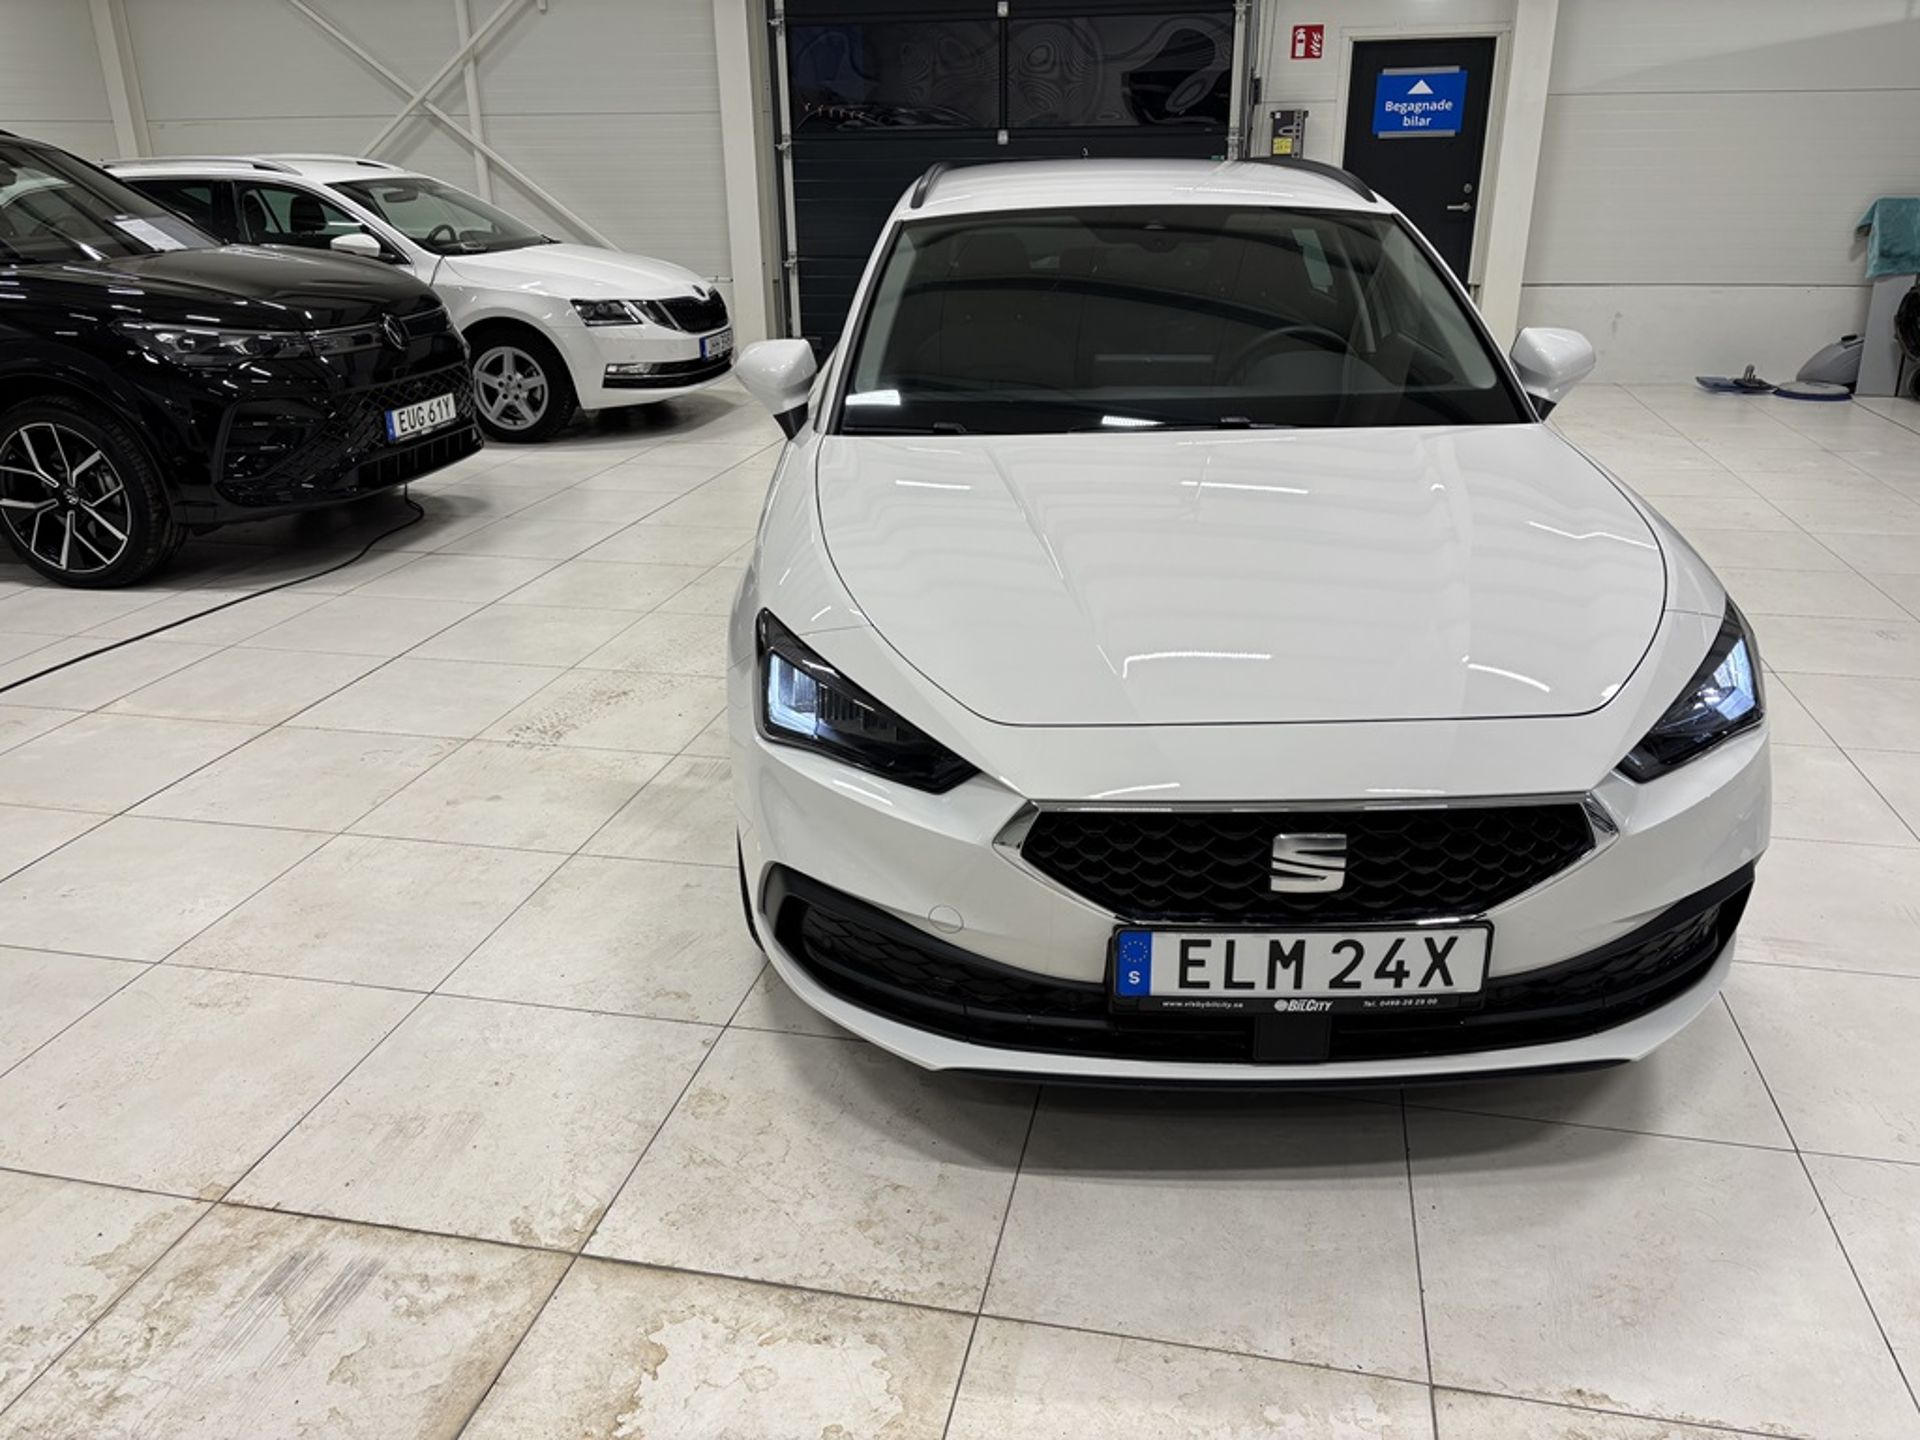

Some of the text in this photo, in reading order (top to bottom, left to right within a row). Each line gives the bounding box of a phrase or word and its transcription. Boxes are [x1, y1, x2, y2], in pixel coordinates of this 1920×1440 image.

[1385, 99, 1453, 114] Begagnade
[1403, 115, 1431, 127] bilar
[398, 396, 451, 433] EUG 61Y
[1178, 935, 1460, 990] ELM 24X
[1128, 970, 1141, 985] S
